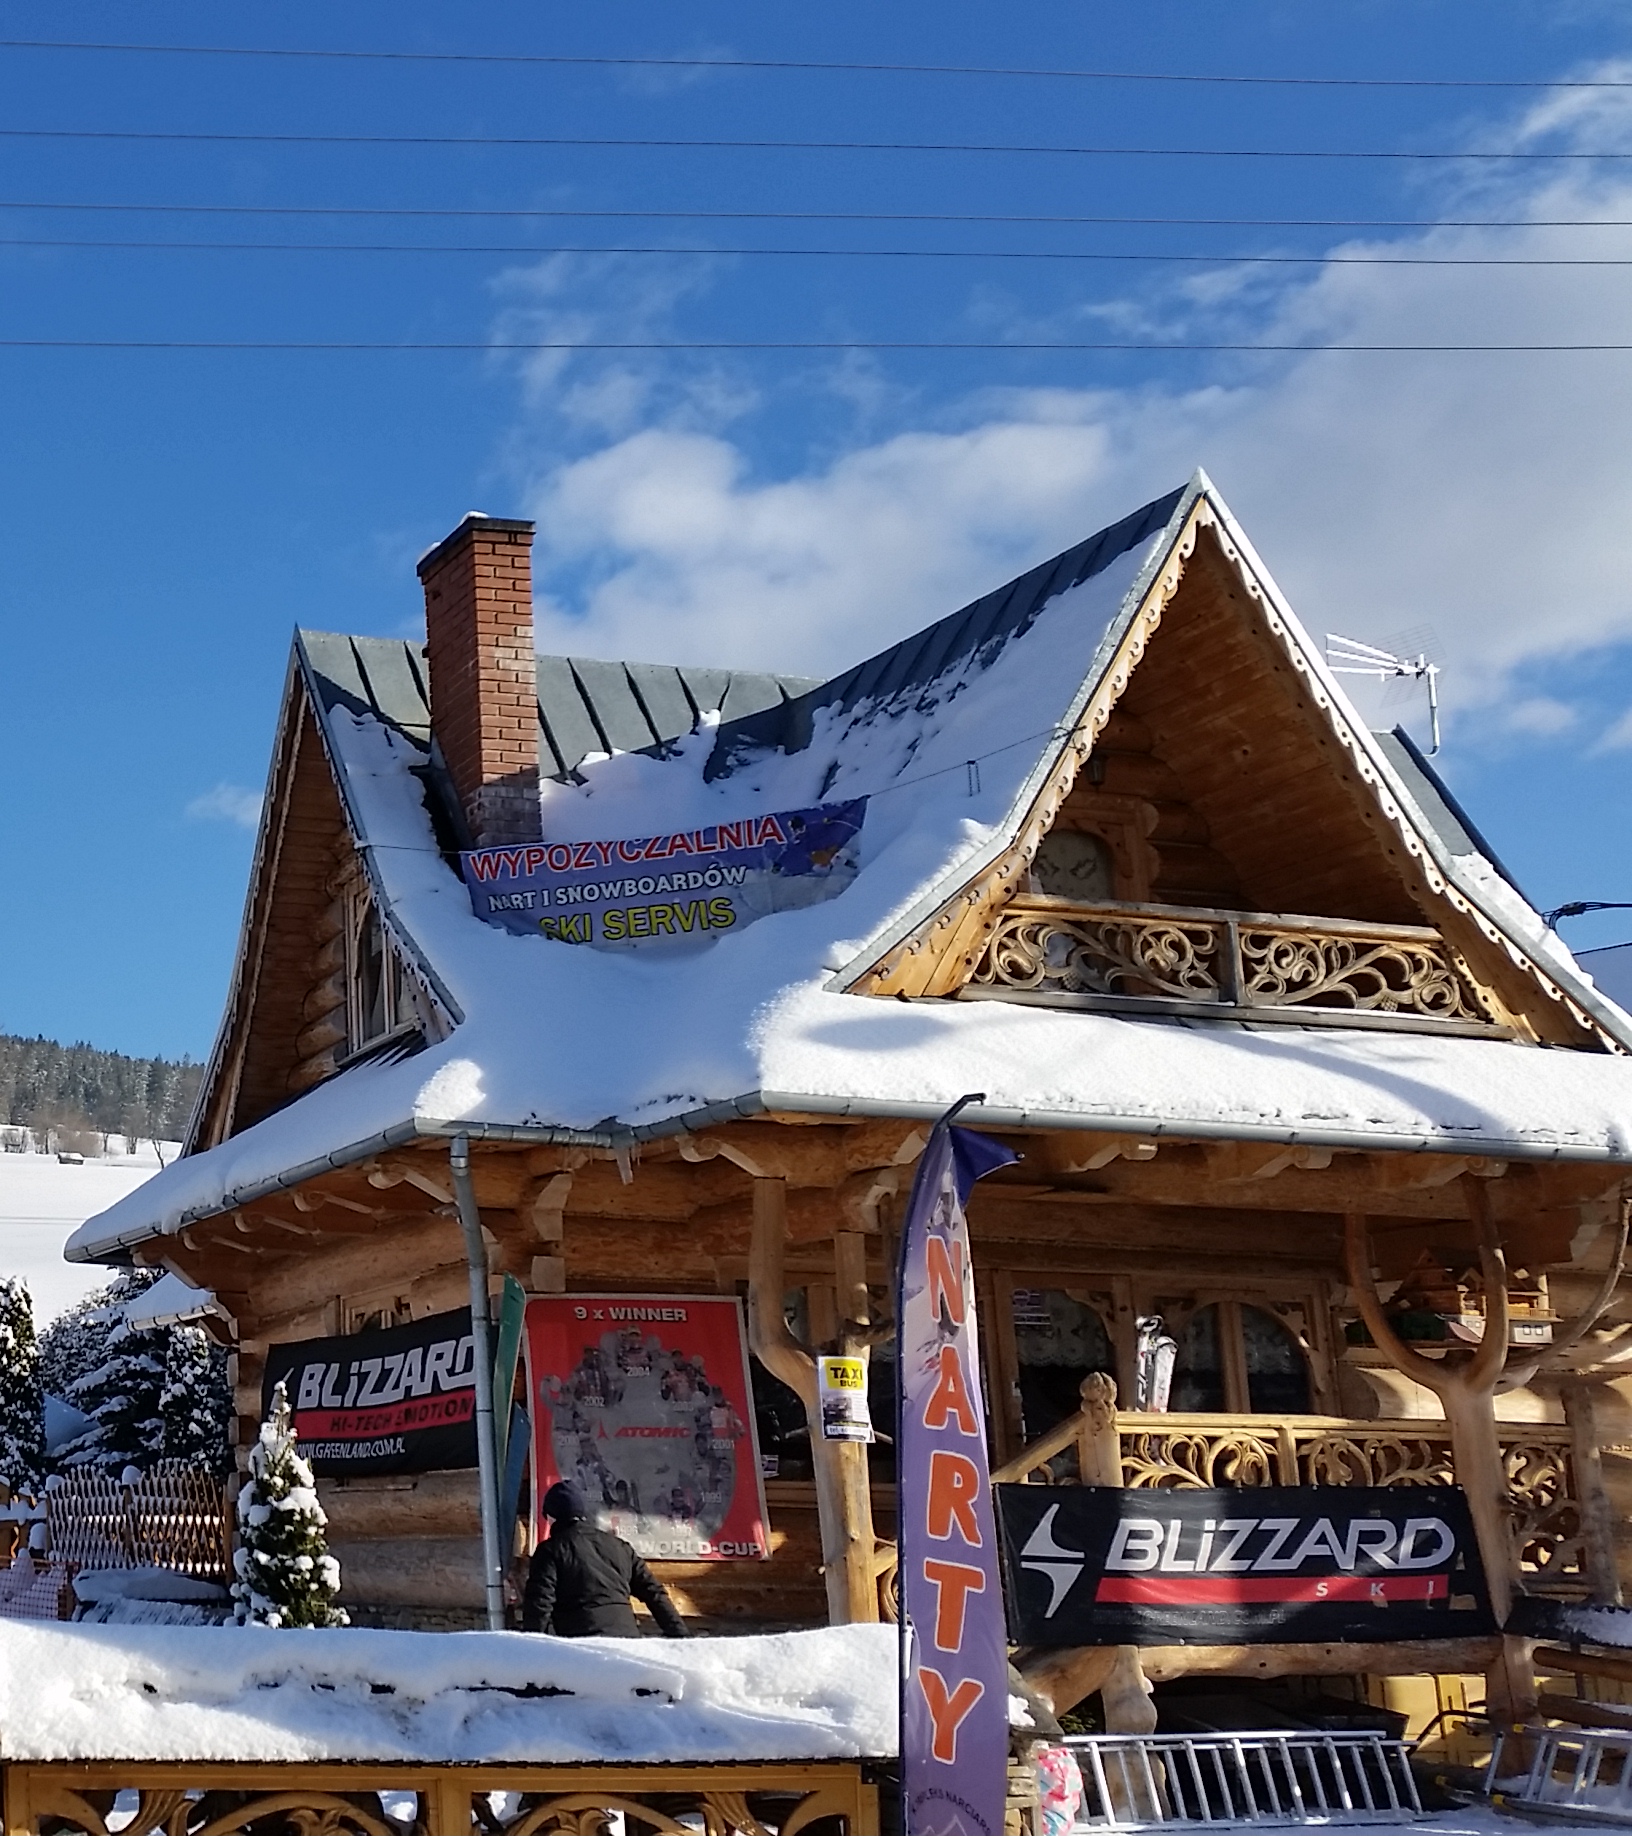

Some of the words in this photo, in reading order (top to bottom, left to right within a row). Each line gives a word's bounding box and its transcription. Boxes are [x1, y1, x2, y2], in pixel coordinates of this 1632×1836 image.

[488, 891, 537, 913] NART
[541, 889, 550, 907] I
[554, 862, 747, 906] SNOWBOARDÓW
[539, 911, 593, 943] SKI
[601, 896, 737, 941] SERVIS
[574, 1306, 587, 1319] 9
[609, 1306, 688, 1322] WINNER
[829, 1366, 864, 1380] TAXI
[839, 1379, 859, 1388] BUS
[329, 1414, 392, 1433] HI-TECH
[615, 1427, 691, 1438] ATOMIC
[917, 1234, 986, 1765] NARTY
[639, 1540, 762, 1557] WORLD-CUP
